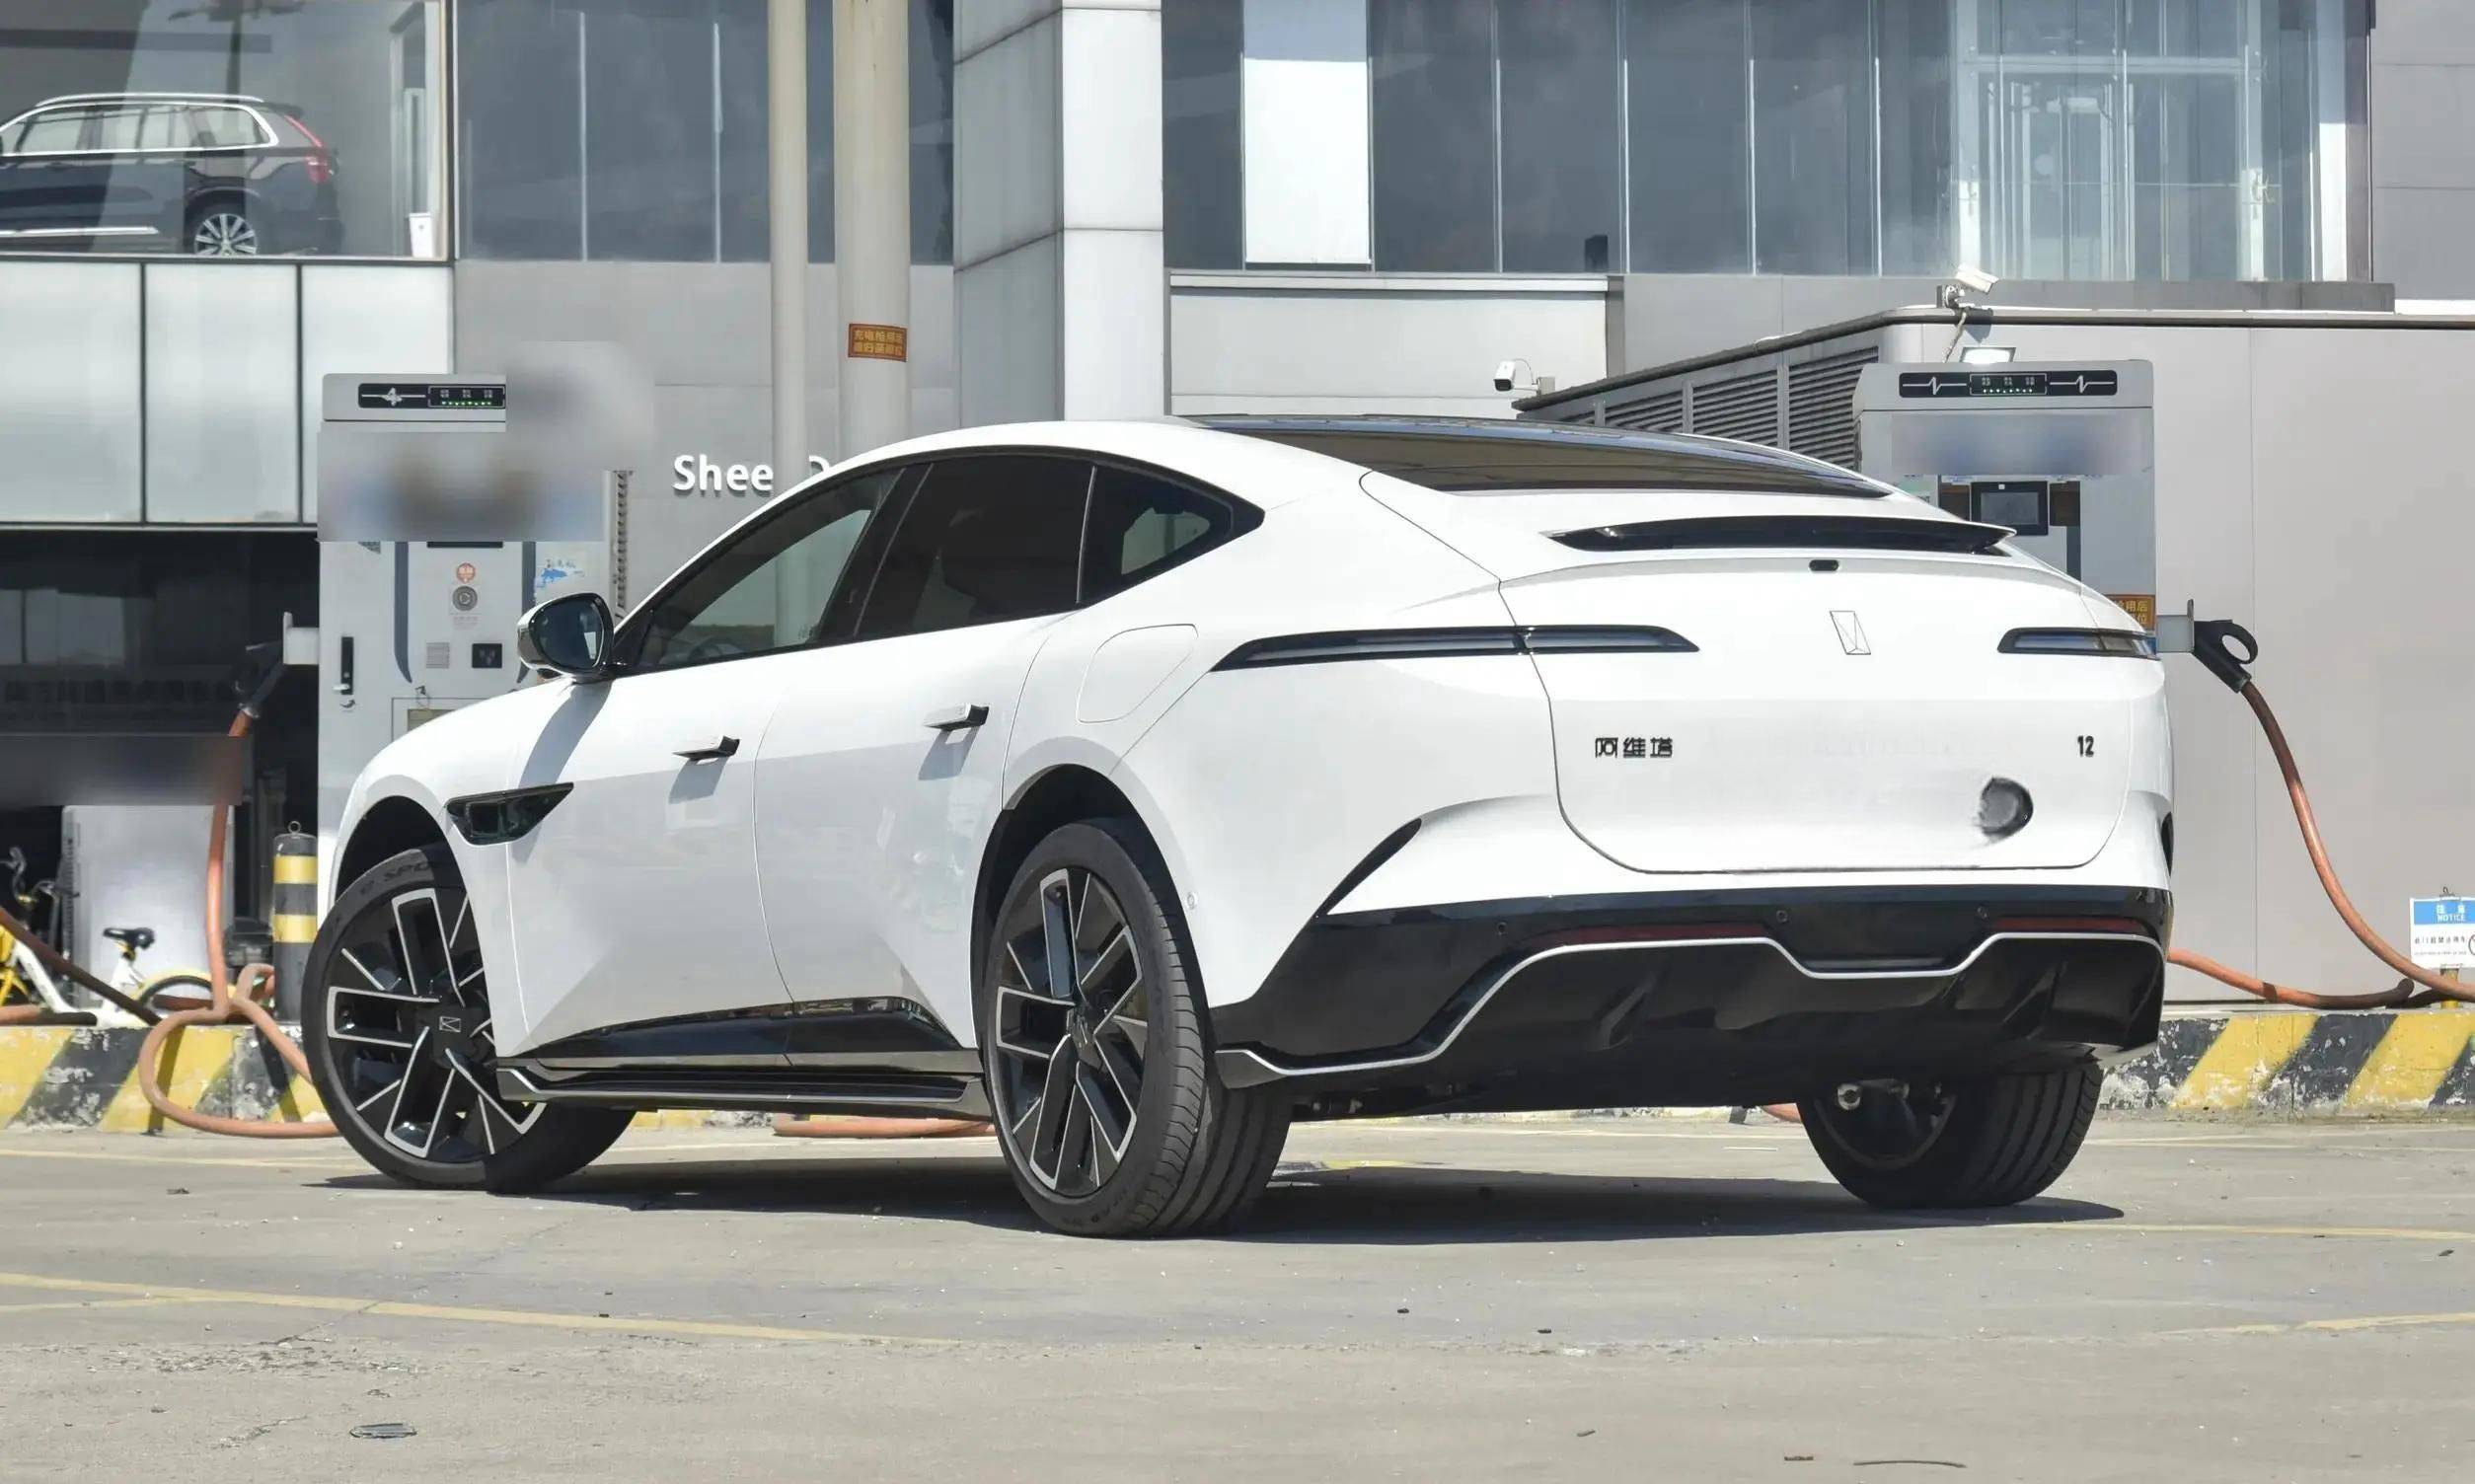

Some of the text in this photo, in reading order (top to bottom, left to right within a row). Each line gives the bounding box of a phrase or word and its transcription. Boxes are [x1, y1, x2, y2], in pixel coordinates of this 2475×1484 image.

[1595, 737, 1673, 758] 阿维塔
[2077, 735, 2094, 758] 12
[2437, 914, 2466, 923] NOTICE
